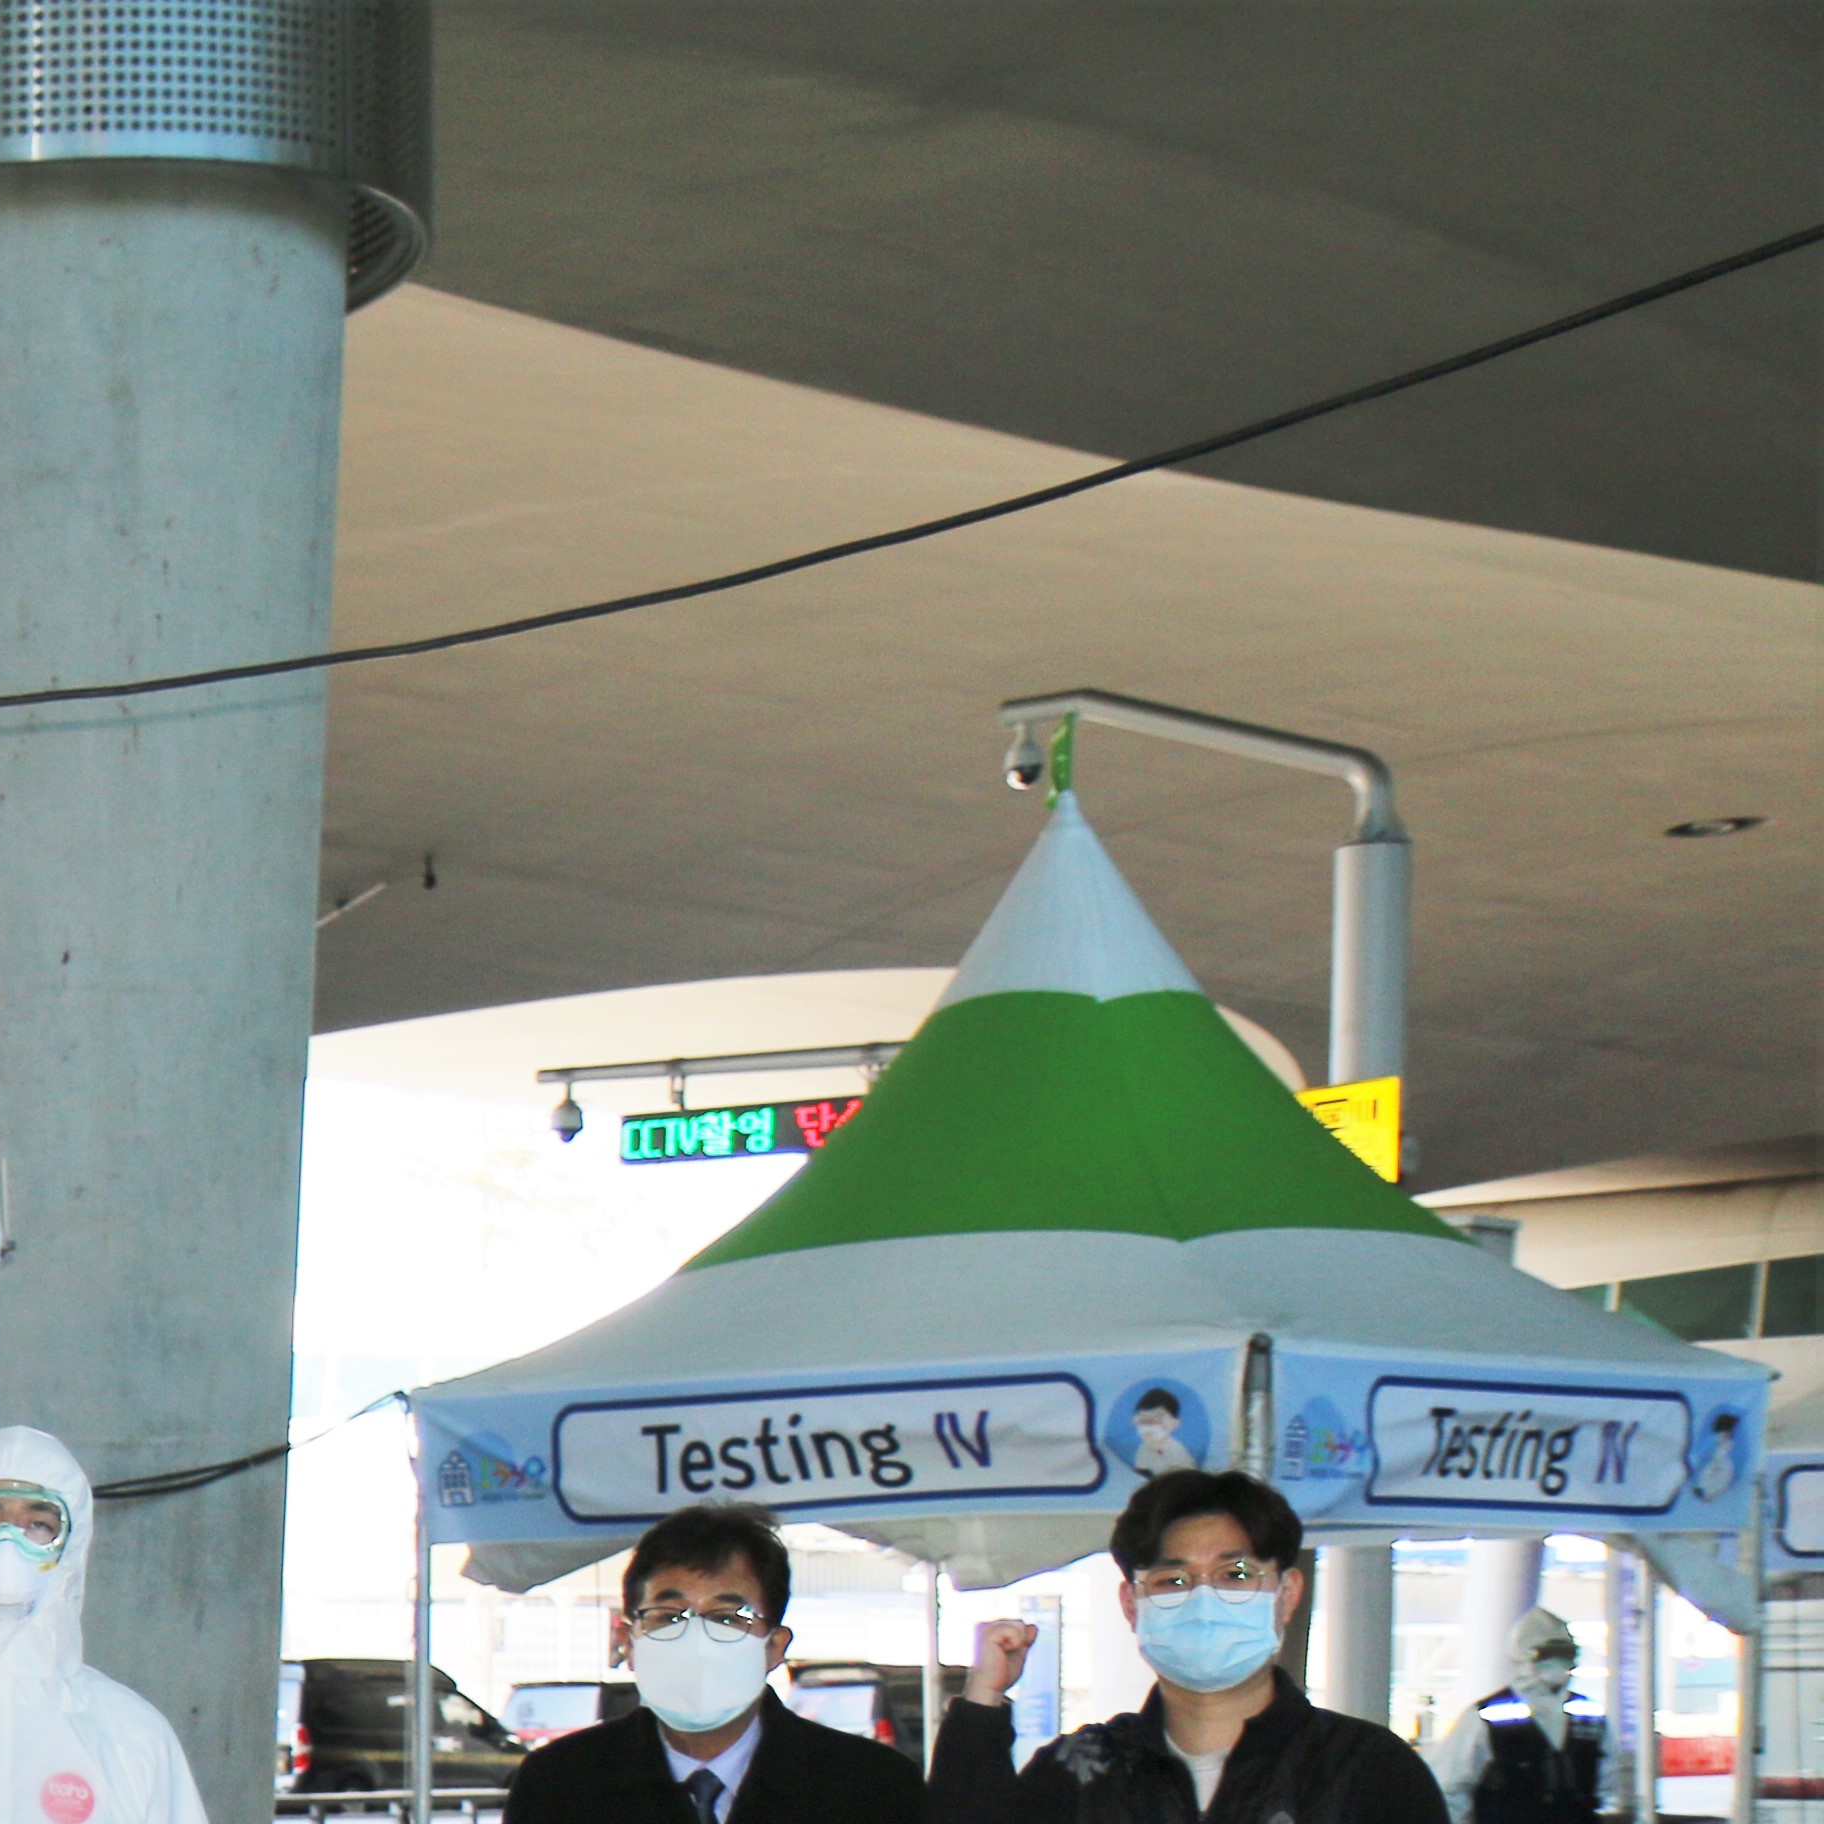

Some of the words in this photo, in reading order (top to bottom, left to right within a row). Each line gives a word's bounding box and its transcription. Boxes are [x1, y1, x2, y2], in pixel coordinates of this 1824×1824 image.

[620, 1107, 776, 1161] CCTV촬영
[794, 1099, 863, 1148] 단
[641, 1413, 914, 1490] Testing
[1422, 1407, 1580, 1496] Testing
